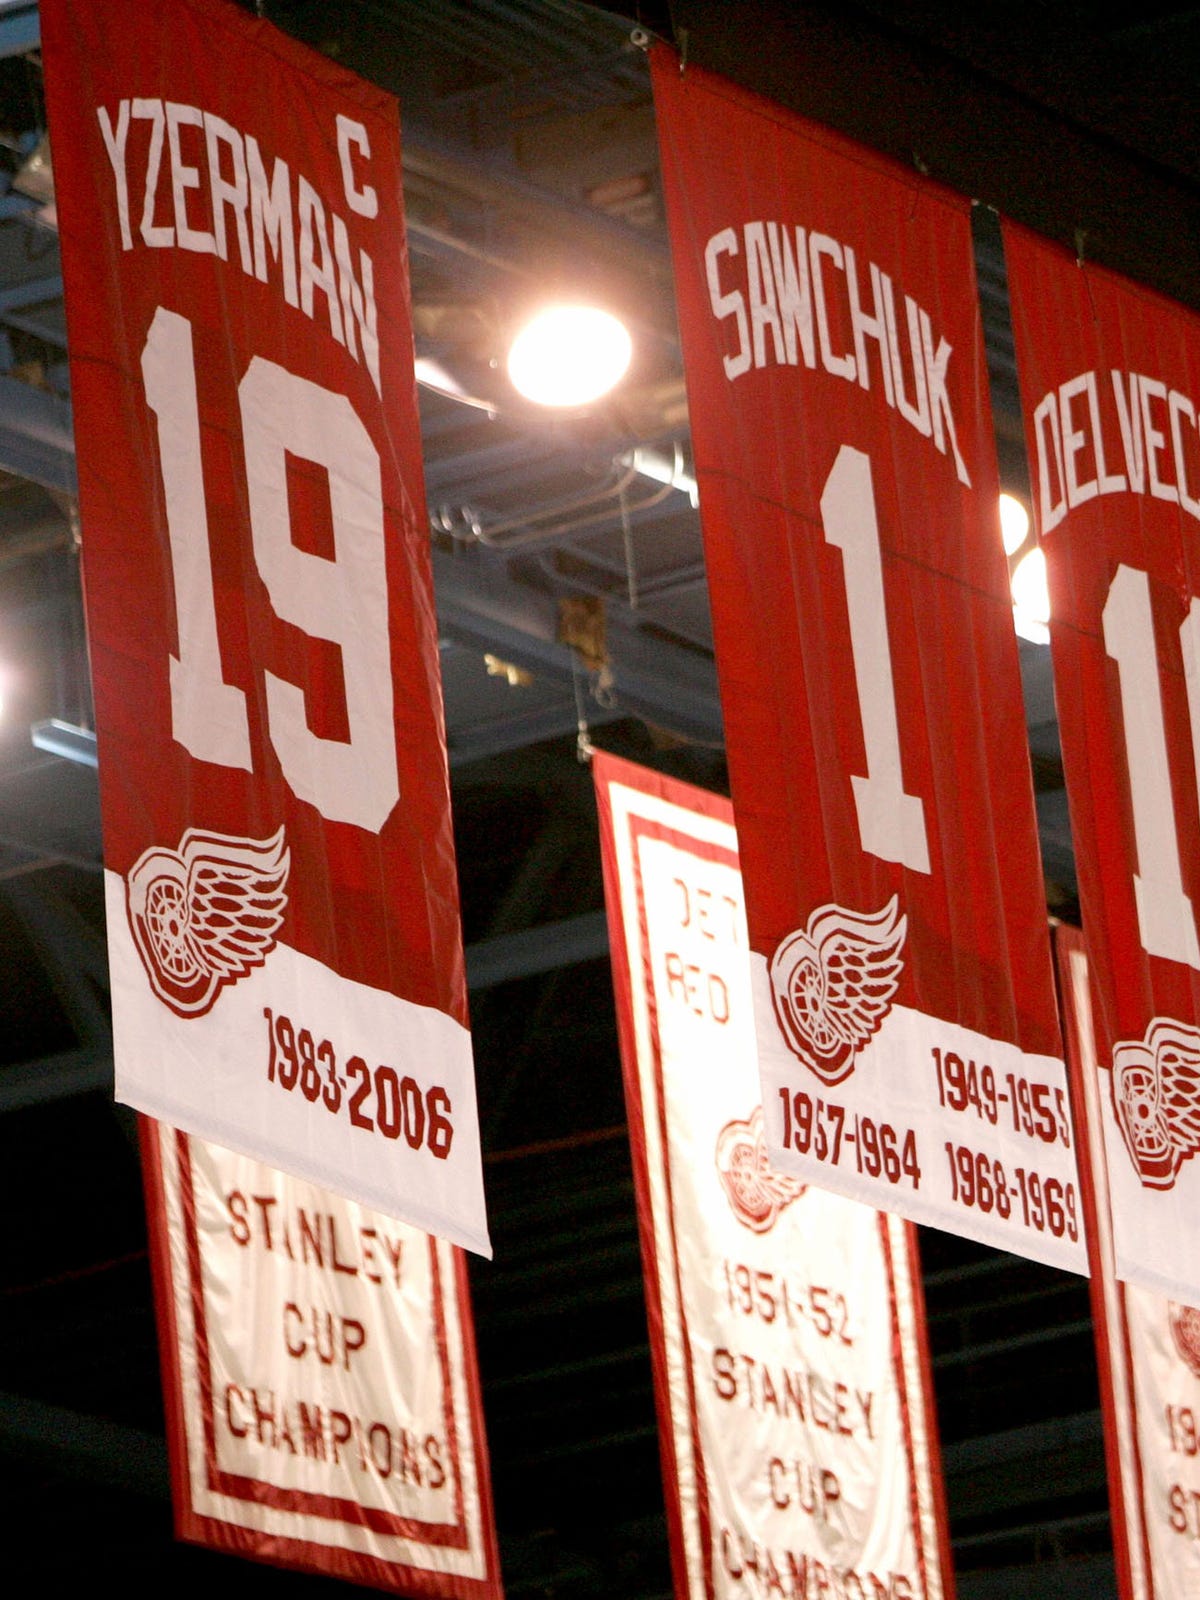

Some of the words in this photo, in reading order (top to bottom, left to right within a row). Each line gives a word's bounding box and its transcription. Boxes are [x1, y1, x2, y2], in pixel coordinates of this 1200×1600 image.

[336, 114, 378, 219] C
[97, 97, 382, 401] YZERMAN
[704, 221, 972, 489] SAWCHUK
[140, 305, 400, 836] 19
[820, 444, 931, 876] 1
[664, 952, 729, 1025] RED
[262, 1007, 454, 1160] 1983-2006
[931, 1047, 1071, 1149] 1949-1955
[779, 1087, 922, 1190] 1957-1964
[225, 1189, 404, 1290] STANLEY
[944, 1141, 1079, 1243] 1968-1969
[283, 1301, 367, 1373] CUP
[722, 1258, 853, 1348] 1951-52
[224, 1383, 446, 1490] CHAMPIONS
[711, 1346, 876, 1441] STANLEY
[767, 1457, 842, 1521] CUP
